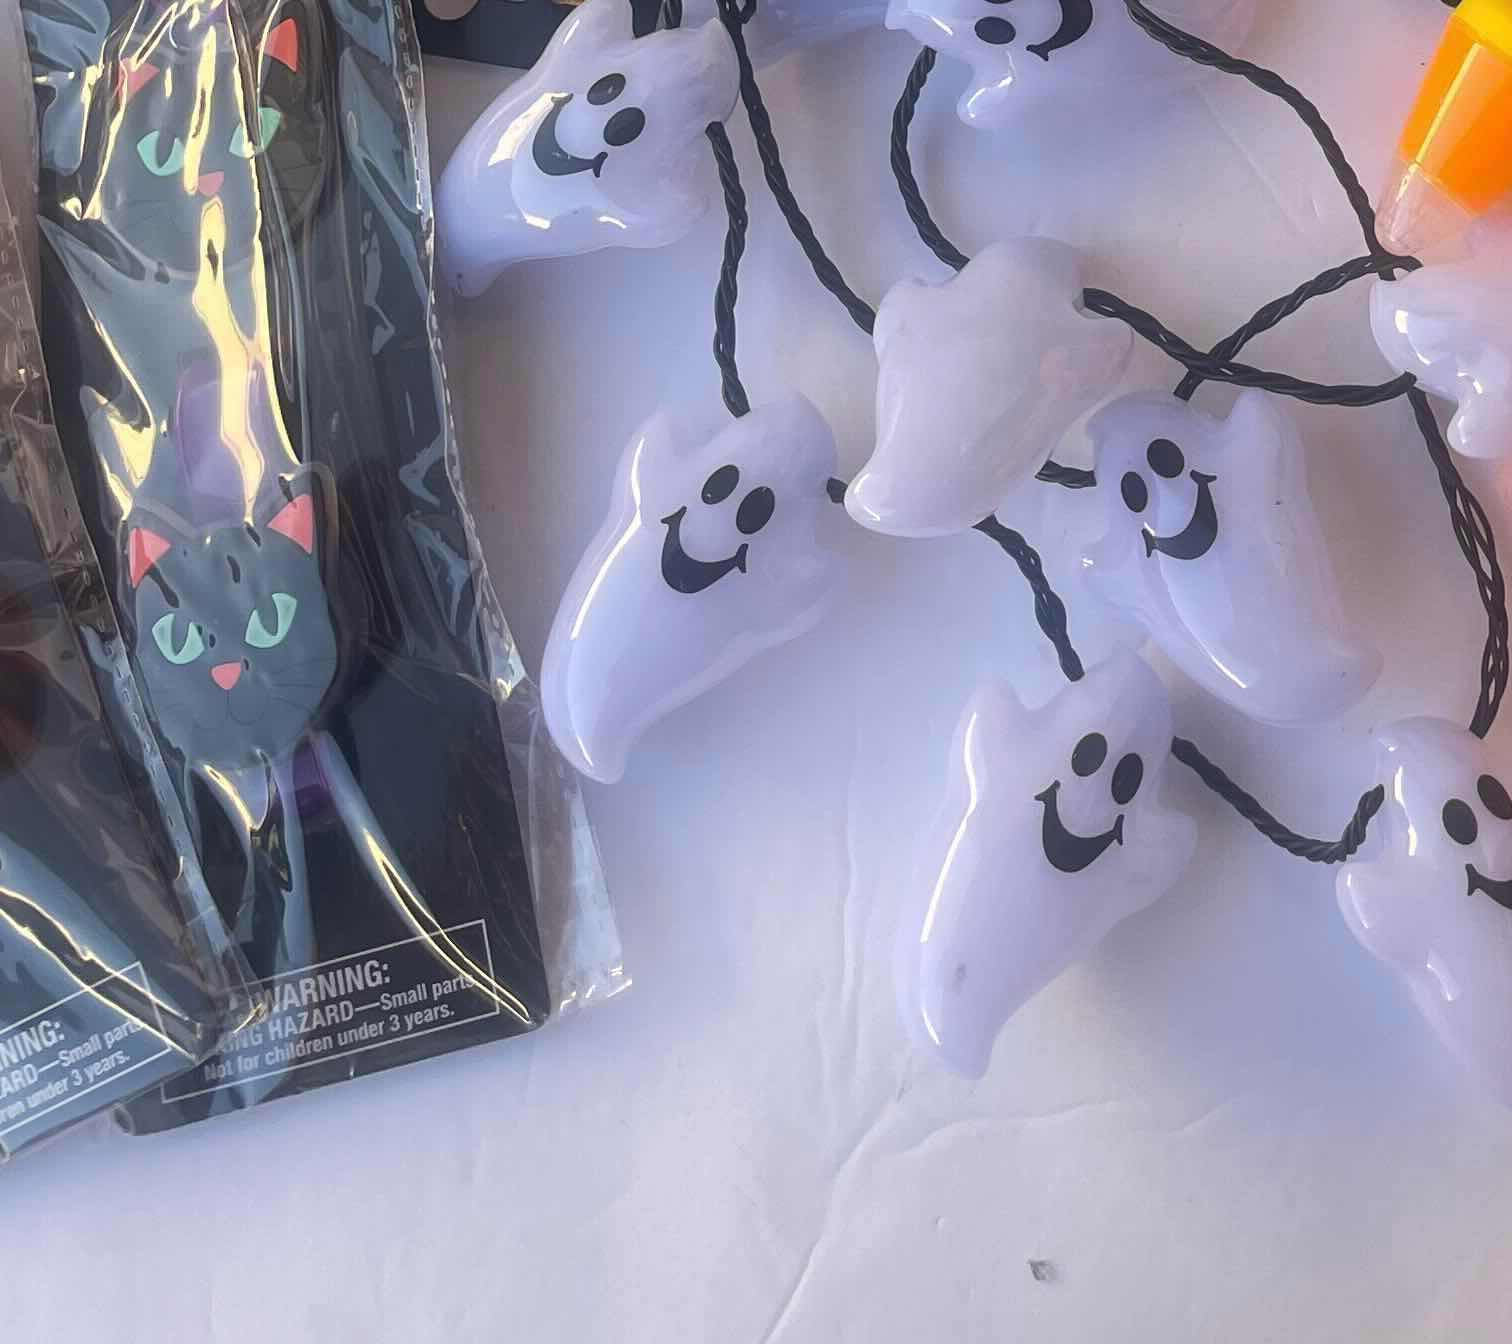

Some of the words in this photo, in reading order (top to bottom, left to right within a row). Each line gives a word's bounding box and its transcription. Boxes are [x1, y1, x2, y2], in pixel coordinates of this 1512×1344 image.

[83, 1050, 131, 1082] years.
[202, 1058, 237, 1082] Not
[237, 1053, 262, 1073] for
[261, 1033, 334, 1067] children
[337, 1020, 385, 1047] under
[403, 1003, 455, 1031] years.
